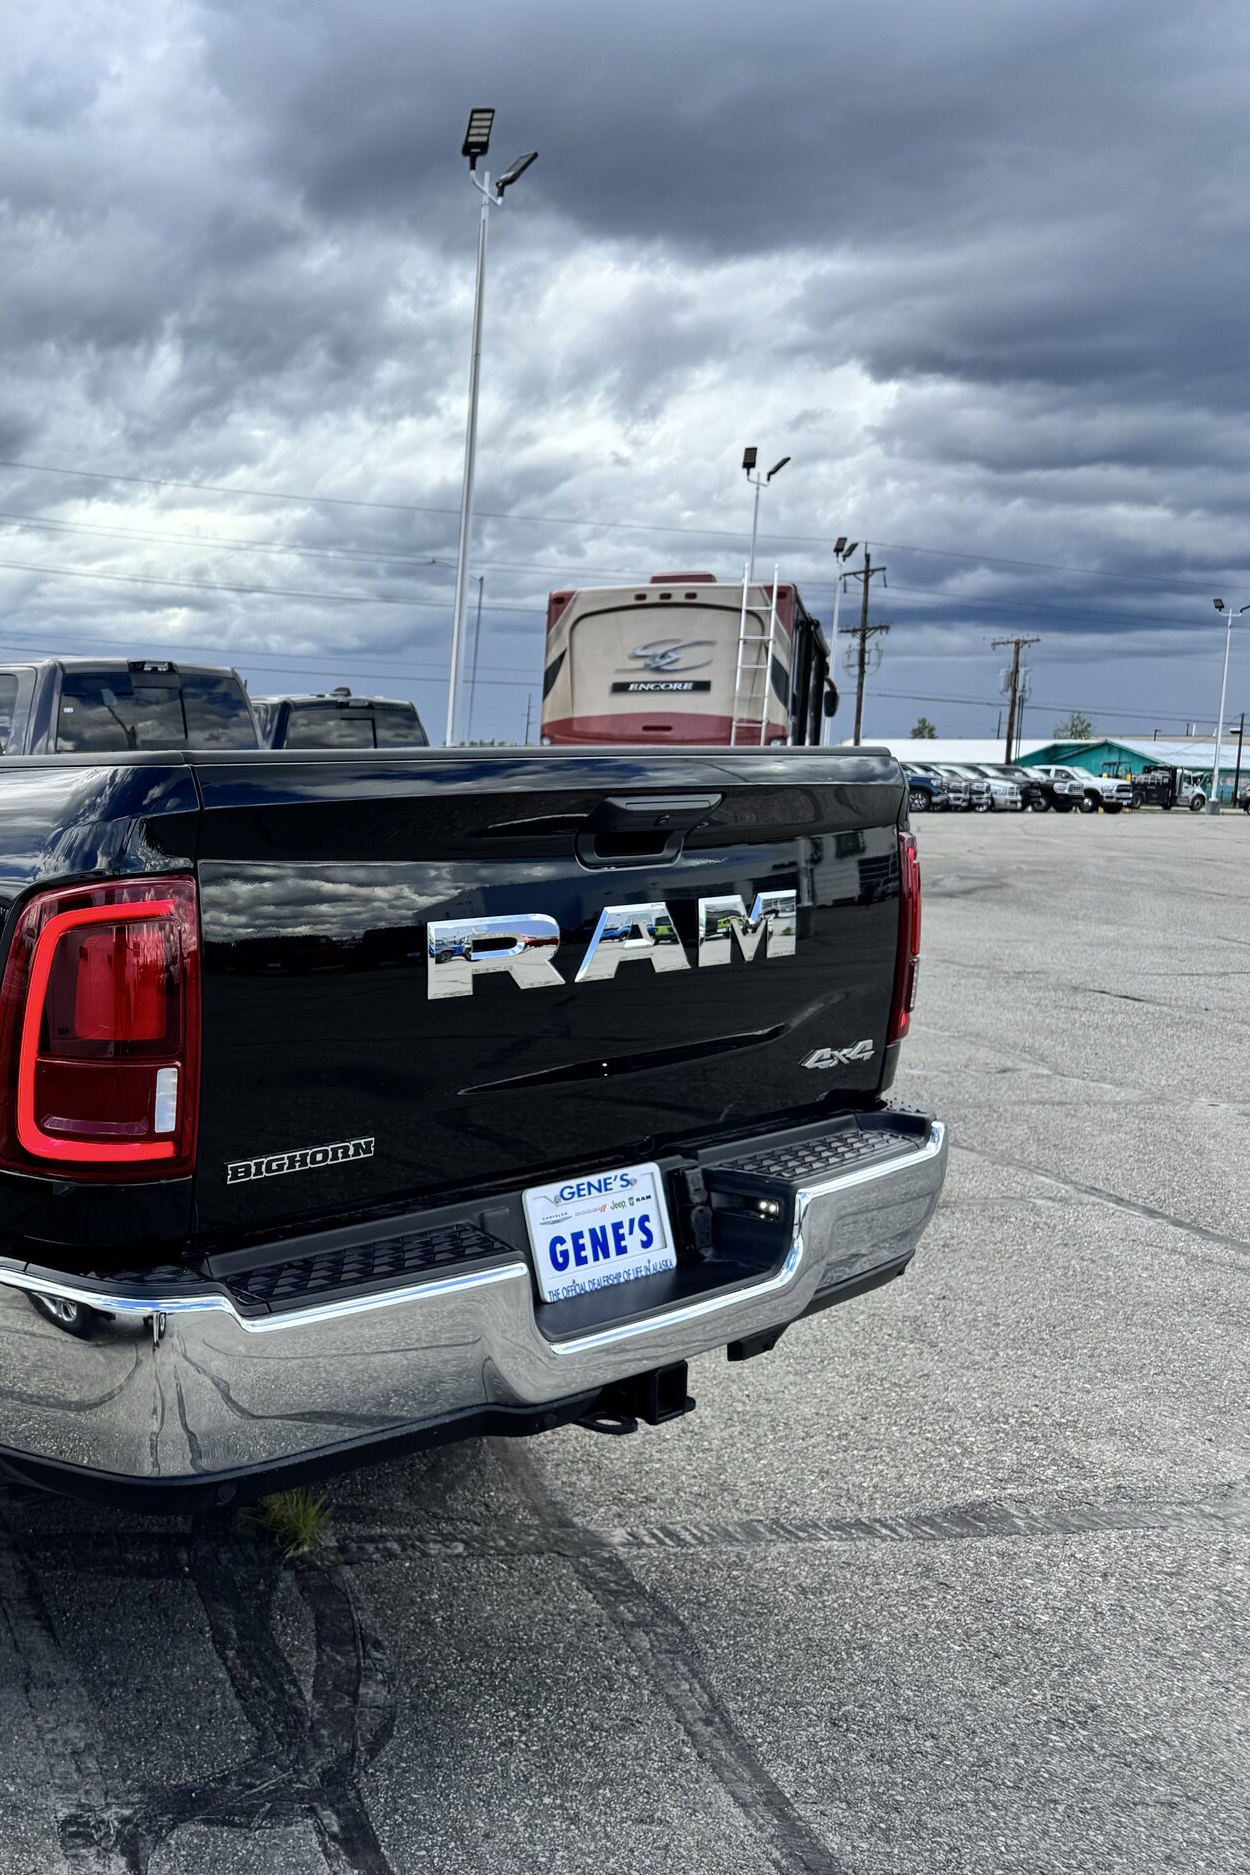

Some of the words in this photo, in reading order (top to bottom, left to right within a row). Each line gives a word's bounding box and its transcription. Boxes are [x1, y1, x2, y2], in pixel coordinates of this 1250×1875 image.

[628, 682, 694, 692] ENCORE
[427, 889, 797, 999] RAM
[799, 1039, 875, 1069] 4x4
[226, 1137, 375, 1185] BIGHORN
[560, 1173, 632, 1202] GENE'S
[610, 1200, 627, 1211] Jeep
[635, 1195, 652, 1203] RAM
[549, 1214, 654, 1272] GENE'S
[548, 1288, 561, 1302] THE
[587, 1272, 622, 1293] DEALERSHIP
[622, 1269, 632, 1282] OF
[632, 1266, 643, 1279] LIFE
[643, 1263, 651, 1277] IN
[651, 1259, 673, 1274] ALASKA
